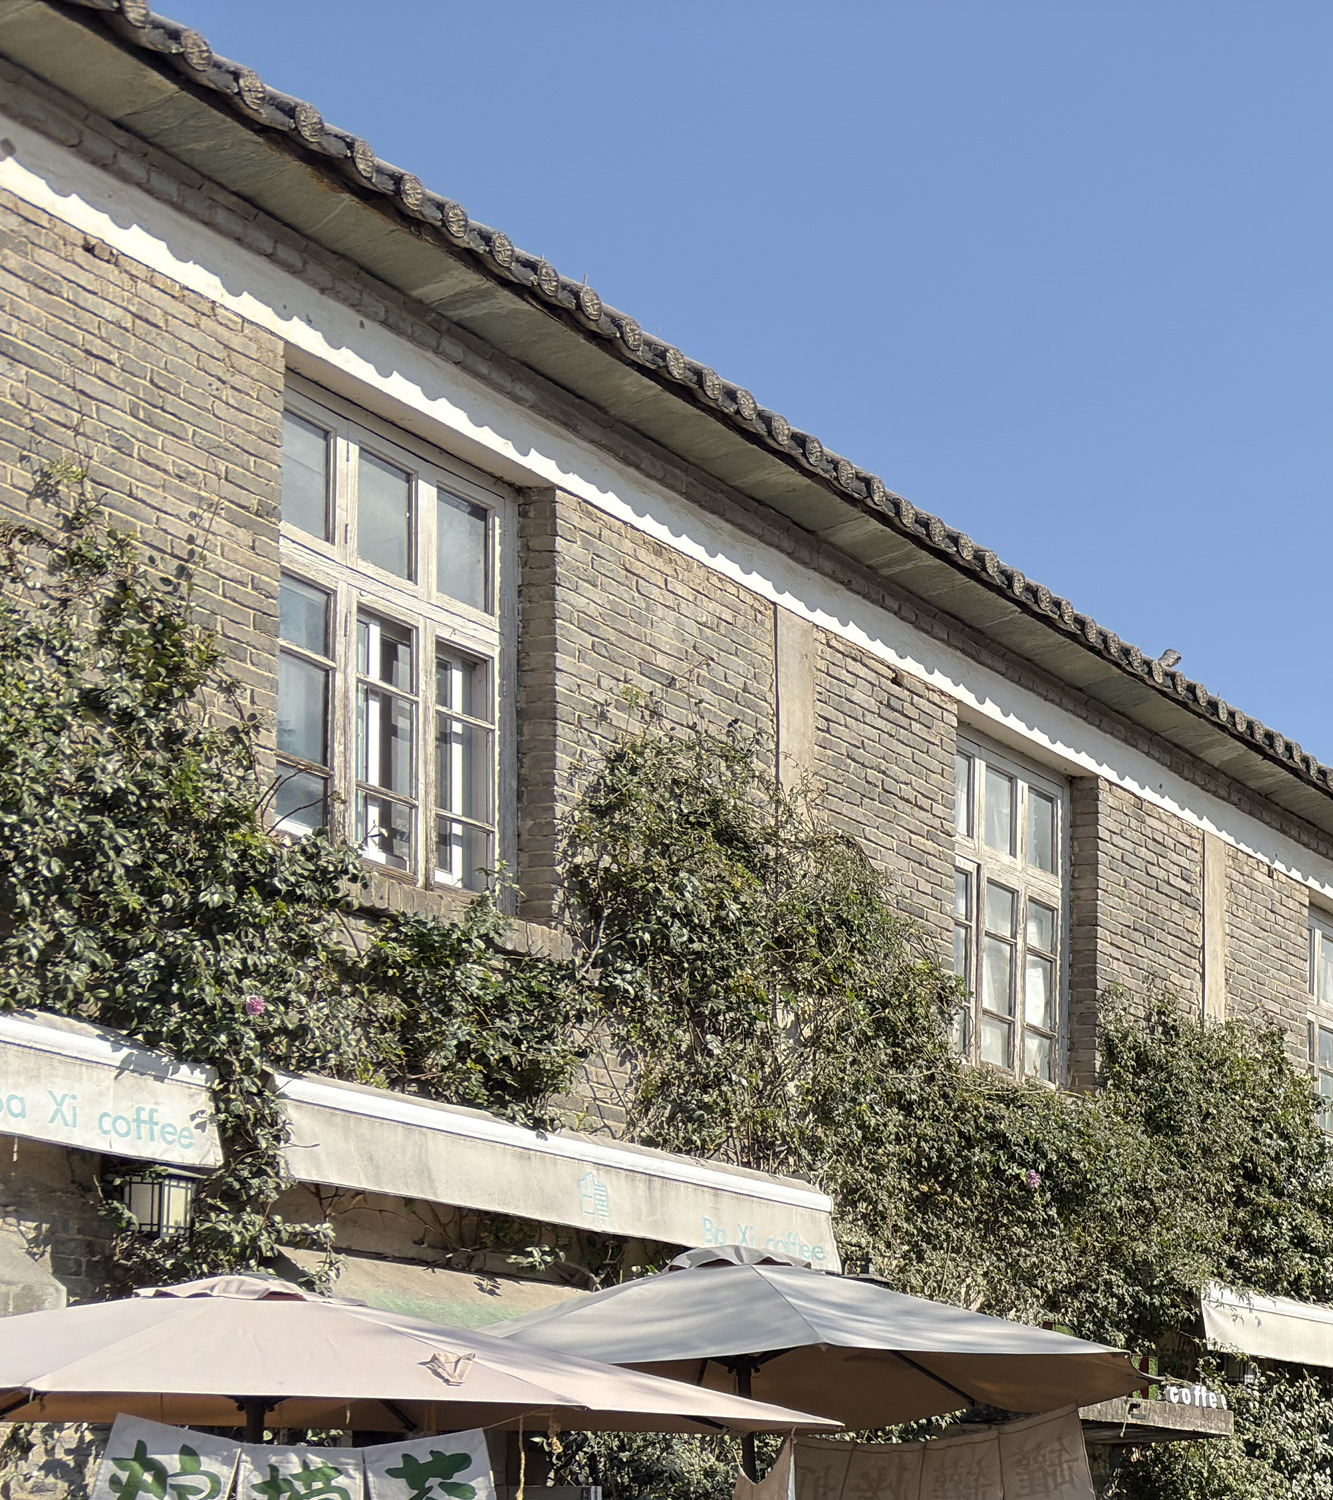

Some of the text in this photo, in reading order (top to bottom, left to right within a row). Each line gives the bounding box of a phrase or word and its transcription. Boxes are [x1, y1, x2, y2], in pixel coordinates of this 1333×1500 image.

[0, 1086, 195, 1149] a Xi coffee
[738, 1223, 755, 1247] Xi
[766, 1231, 827, 1261] coffee
